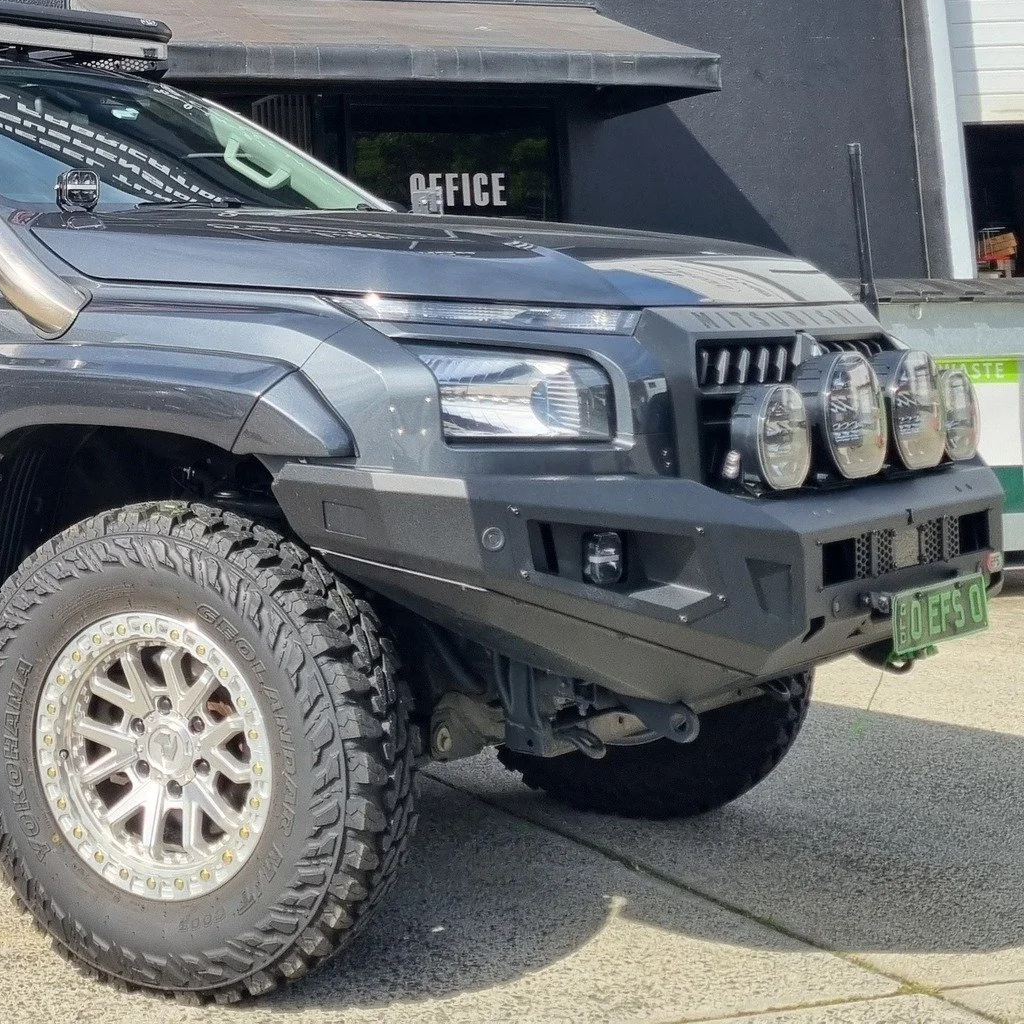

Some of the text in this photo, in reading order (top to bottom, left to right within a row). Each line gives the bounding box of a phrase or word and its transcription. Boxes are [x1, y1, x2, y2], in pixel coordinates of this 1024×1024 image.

[690, 307, 864, 329] MITSUBISHI
[3, 657, 52, 863] YOKOHAMA
[197, 603, 298, 838] GEOLANDAR
